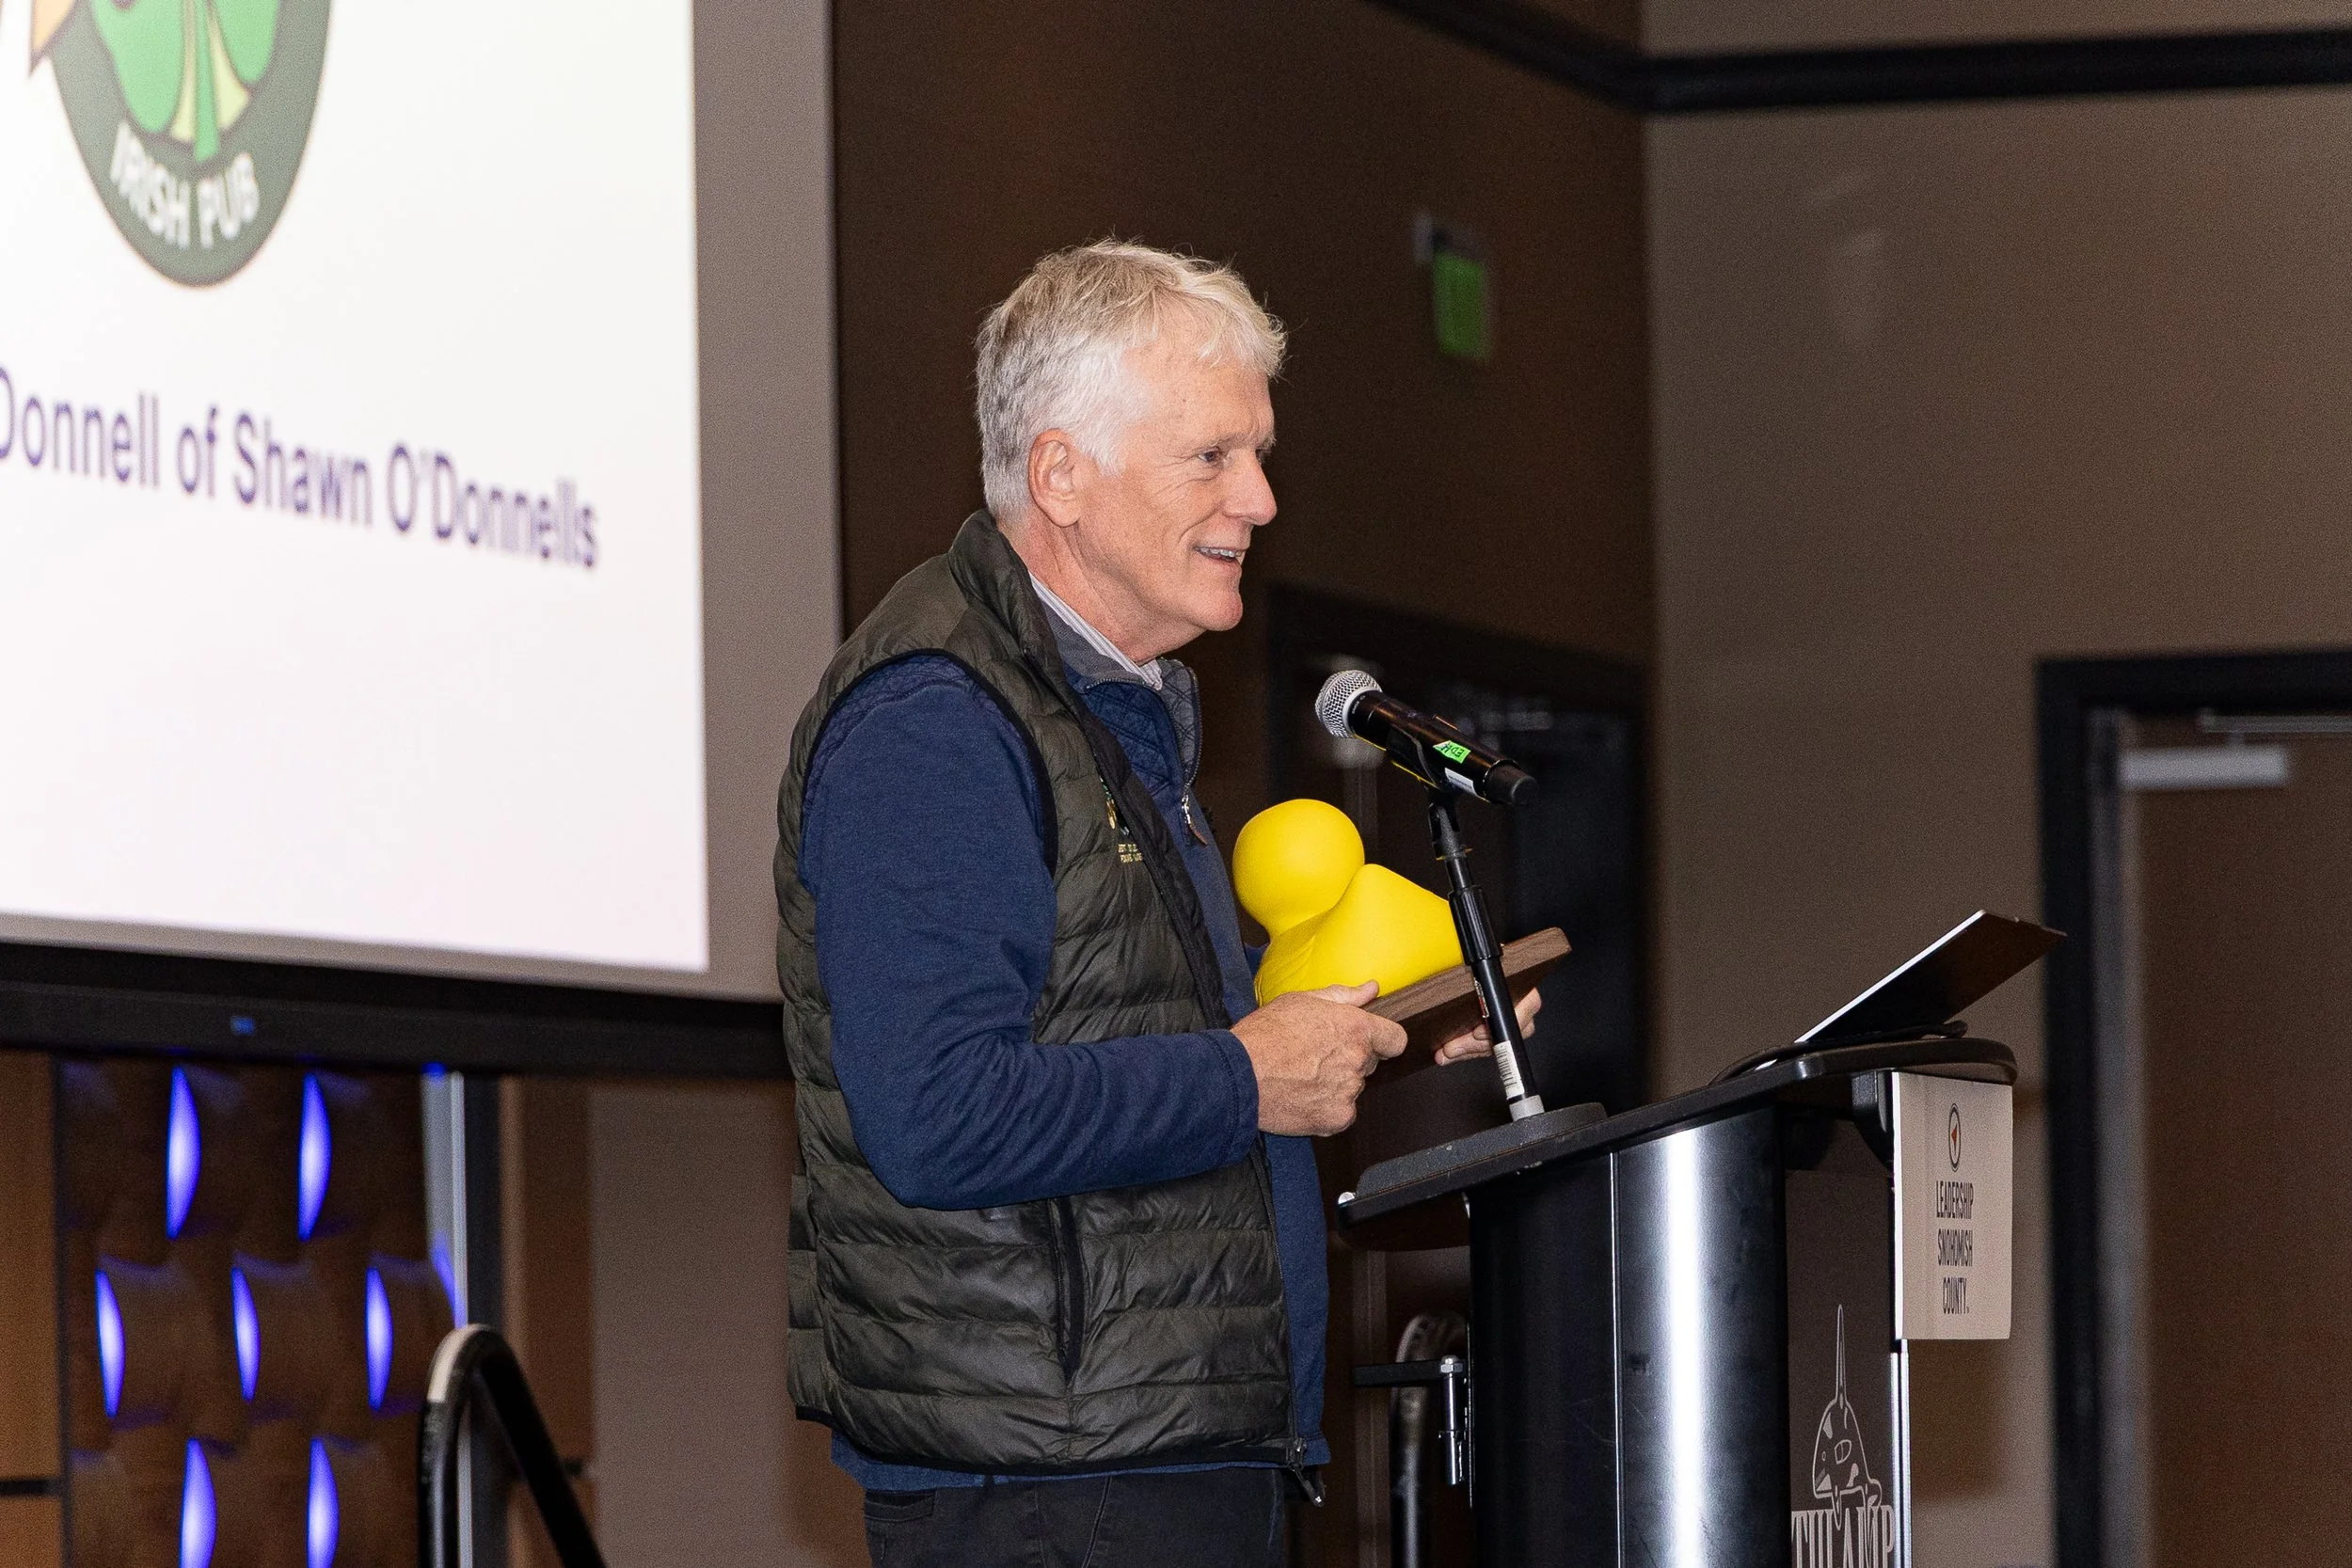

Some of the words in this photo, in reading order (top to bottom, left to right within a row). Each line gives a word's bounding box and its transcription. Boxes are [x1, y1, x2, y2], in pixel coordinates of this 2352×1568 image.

[110, 119, 190, 250] IRISH
[198, 150, 261, 248] PUB
[177, 403, 218, 499] of
[233, 410, 373, 529] Shawn
[387, 440, 597, 569] O'Donnells
[1936, 1180, 1974, 1220] LEADERSHIP
[1937, 1228, 1973, 1267] SNOHOMISH
